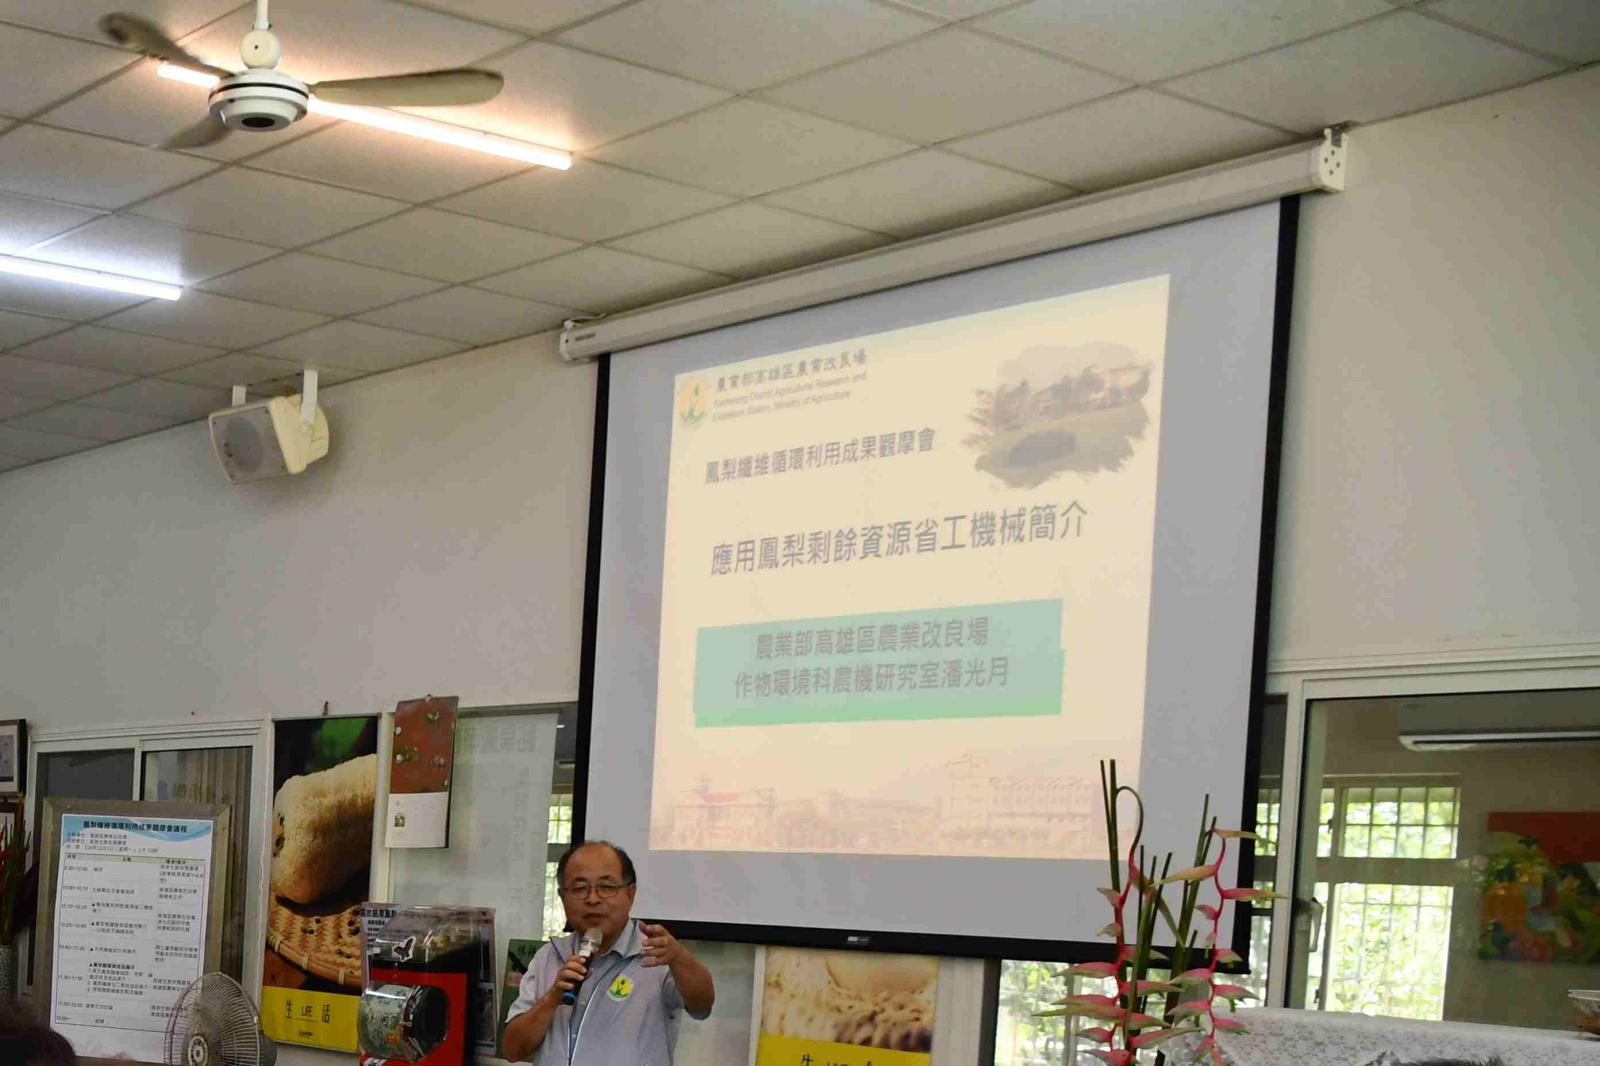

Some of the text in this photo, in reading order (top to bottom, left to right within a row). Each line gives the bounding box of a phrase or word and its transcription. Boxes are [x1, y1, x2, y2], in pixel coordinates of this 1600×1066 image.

[705, 427, 936, 483] 鳳梨纖維循環利用成果觀摩會
[710, 500, 1089, 577] 應用鳳梨剩餘資源省工機械簡介
[755, 616, 990, 661] 農業部高雄區農業改良場
[734, 655, 1009, 700] 作物環境科農機研究室潘光月
